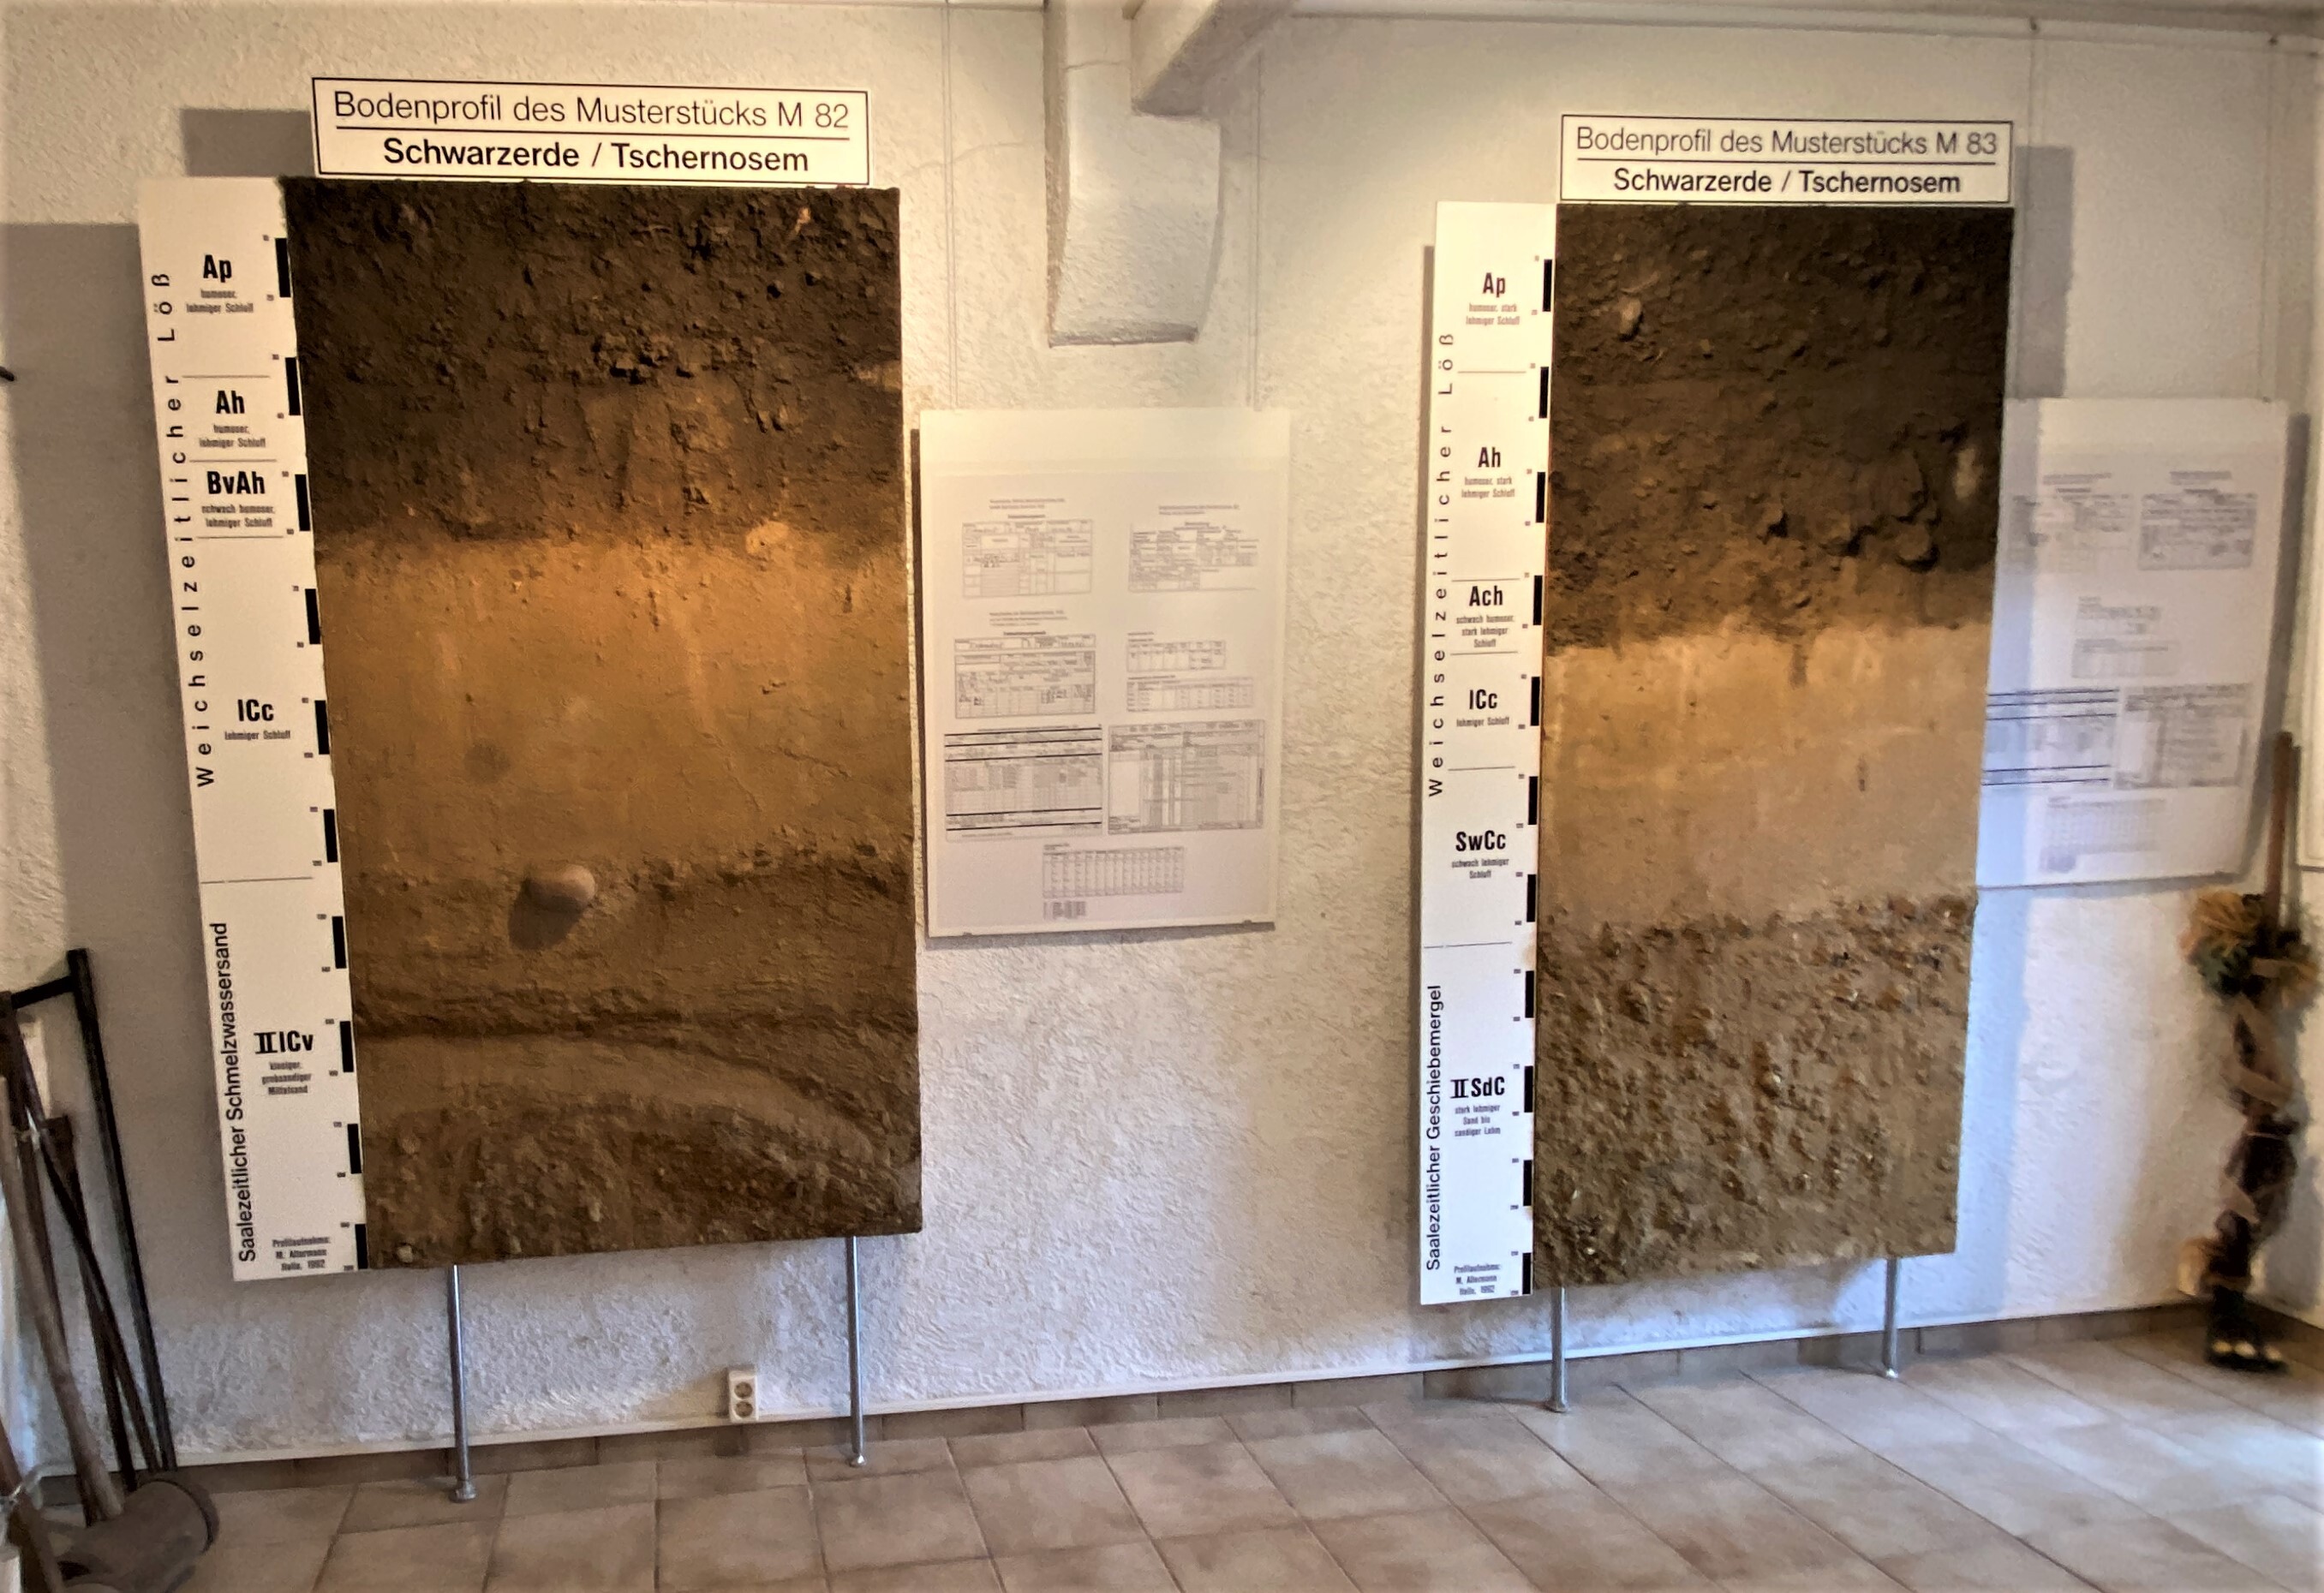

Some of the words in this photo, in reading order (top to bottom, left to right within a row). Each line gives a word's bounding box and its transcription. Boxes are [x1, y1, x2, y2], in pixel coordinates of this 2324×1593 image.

[334, 91, 501, 126] Bodenprofil
[514, 97, 565, 122] des
[577, 96, 768, 128] Musterstücks
[777, 102, 803, 128] M
[815, 104, 849, 130] 82
[383, 137, 579, 168] Schwarzerde
[591, 141, 602, 168] /
[611, 141, 809, 172] Tschernosem
[1576, 127, 1712, 157] Bodenprofil
[1720, 130, 1763, 153] des
[1771, 129, 1927, 155] Musterstücks
[1936, 132, 1958, 155] M
[1967, 133, 1998, 155] 83
[1613, 166, 1772, 193] Schwarzerde
[1780, 170, 1791, 194] /
[1798, 170, 1962, 194] Tschernosem
[203, 254, 232, 283] Ap
[1483, 272, 1506, 298] Ap
[152, 272, 175, 342] Löß
[1437, 333, 1455, 396] Löß
[216, 390, 245, 415] Ah
[1478, 446, 1501, 468] Ah
[206, 471, 266, 495] BvAh
[164, 375, 215, 787] Weichselzeitlicher
[1469, 585, 1503, 606] Ach
[1428, 427, 1453, 797] Weichselzeitlicher
[1455, 830, 1506, 852] SwCc
[209, 922, 244, 1120] Schmelzwassersand
[1426, 985, 1445, 1140] Geschiebemergel
[232, 1127, 255, 1262] Saalezeitlicher
[1426, 1146, 1442, 1270] Saalezeitlicher
